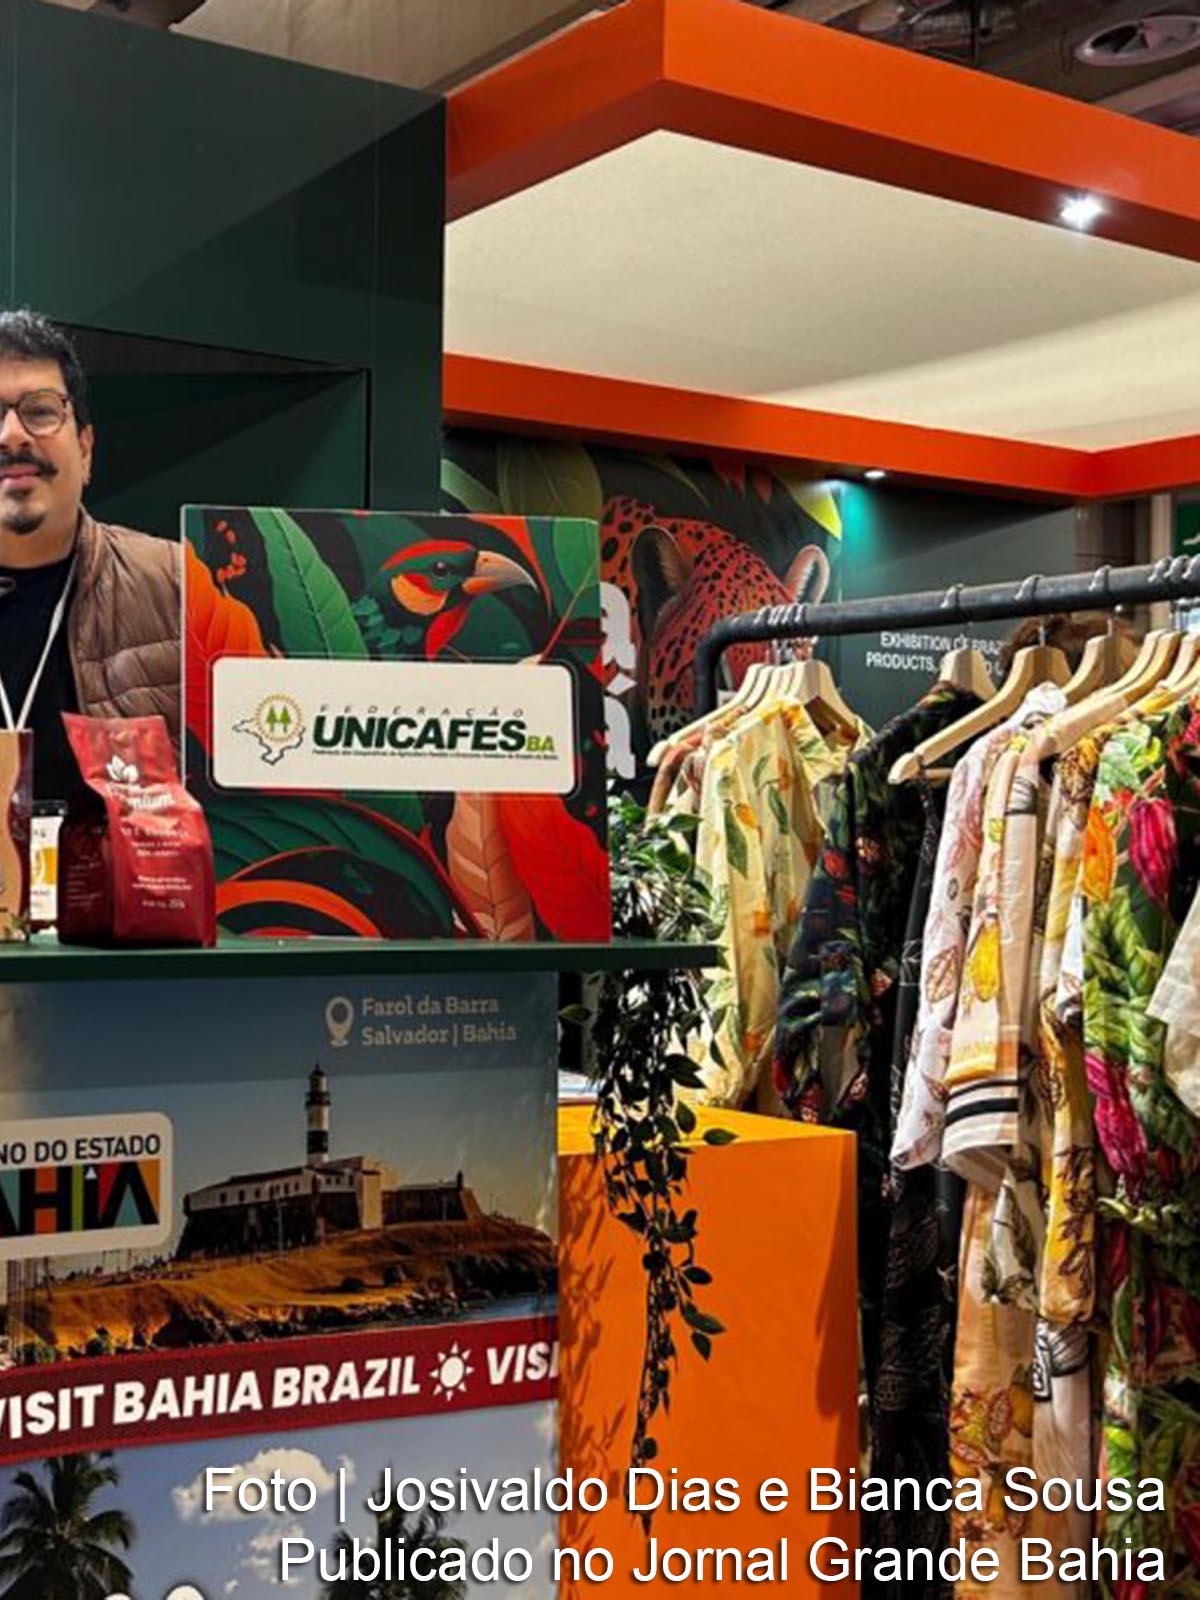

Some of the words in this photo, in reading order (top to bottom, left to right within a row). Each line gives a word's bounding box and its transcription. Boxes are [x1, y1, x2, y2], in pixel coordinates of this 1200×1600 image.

[880, 630, 950, 651] EXHIBITION
[313, 715, 526, 753] UNICAFES
[525, 735, 555, 753] BA
[362, 995, 414, 1017] Farol
[417, 994, 442, 1015] da
[445, 996, 498, 1015] Barra
[362, 1024, 449, 1047] Salvador
[463, 1022, 518, 1042] Bahia
[35, 1140, 68, 1163] DO
[75, 1133, 162, 1160] ESTADO
[113, 1370, 263, 1425] BAHIA
[272, 1355, 421, 1409] BRAZIL
